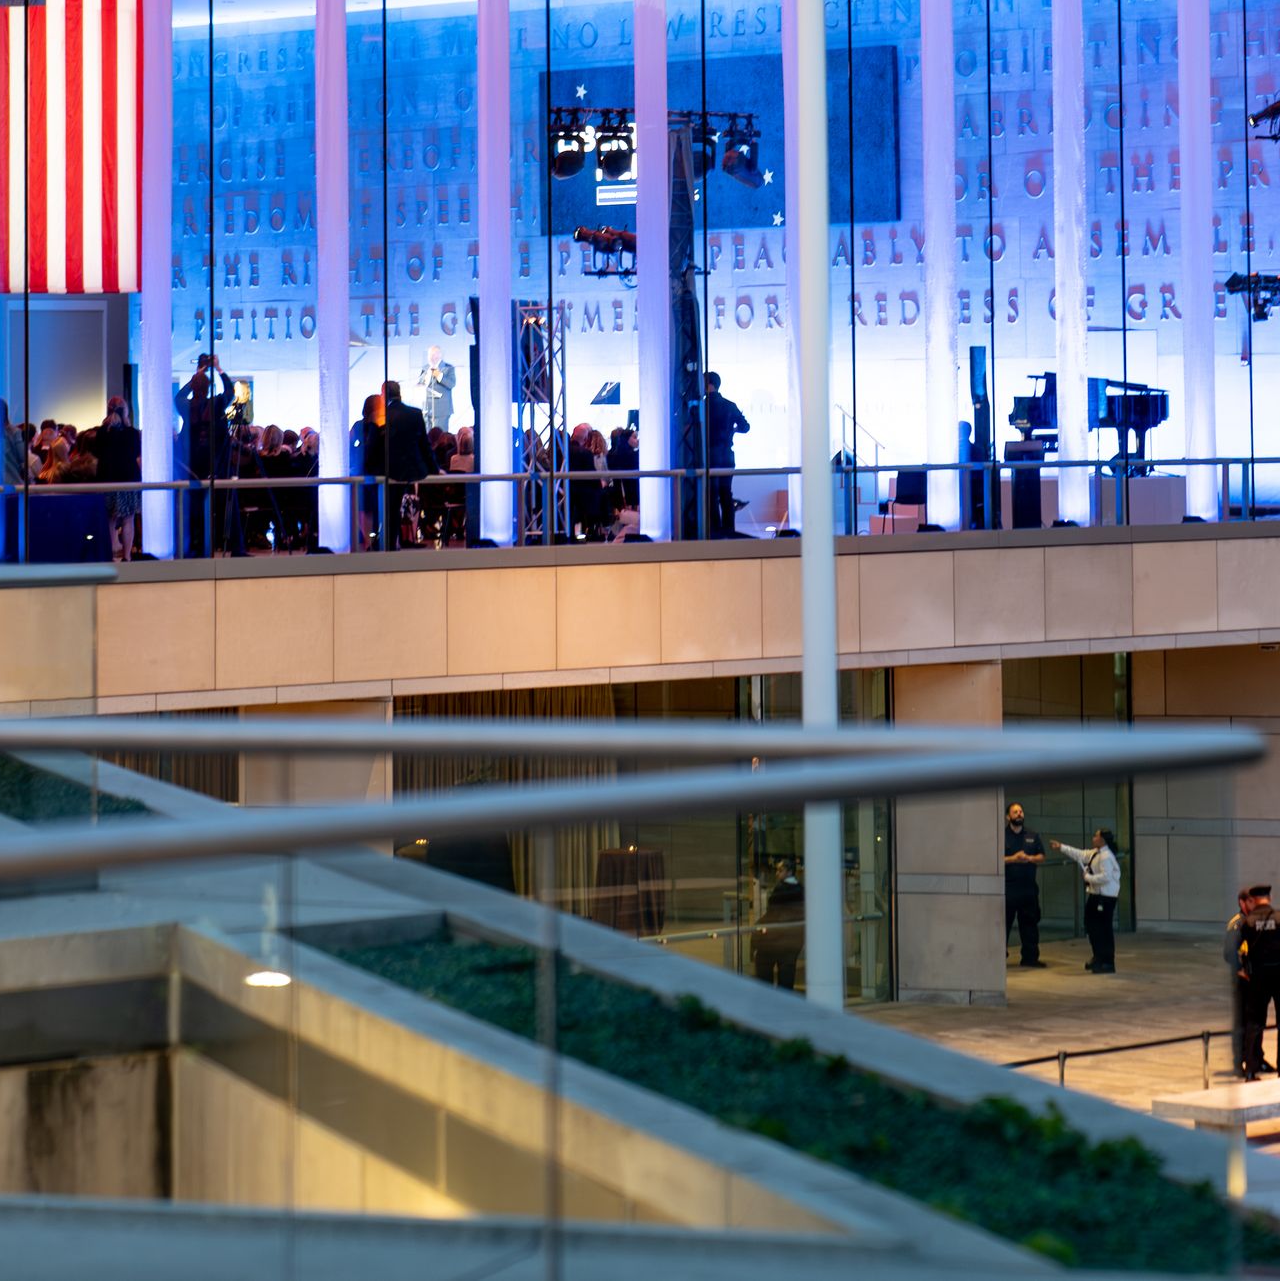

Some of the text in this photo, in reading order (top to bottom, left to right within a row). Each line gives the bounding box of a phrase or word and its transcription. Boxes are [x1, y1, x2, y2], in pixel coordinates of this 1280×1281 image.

[549, 20, 600, 51] NO
[617, 9, 685, 47] LW
[183, 207, 317, 238] REEDOM
[1100, 162, 1180, 196] THE
[406, 255, 443, 284] OF
[467, 249, 531, 280] TE
[956, 231, 1007, 263] TO
[1033, 222, 1274, 262] ASEMLE,
[196, 316, 317, 344] PETITIO
[361, 314, 421, 339] THE
[714, 301, 786, 330] FOR
[848, 294, 1020, 328] REDESS
